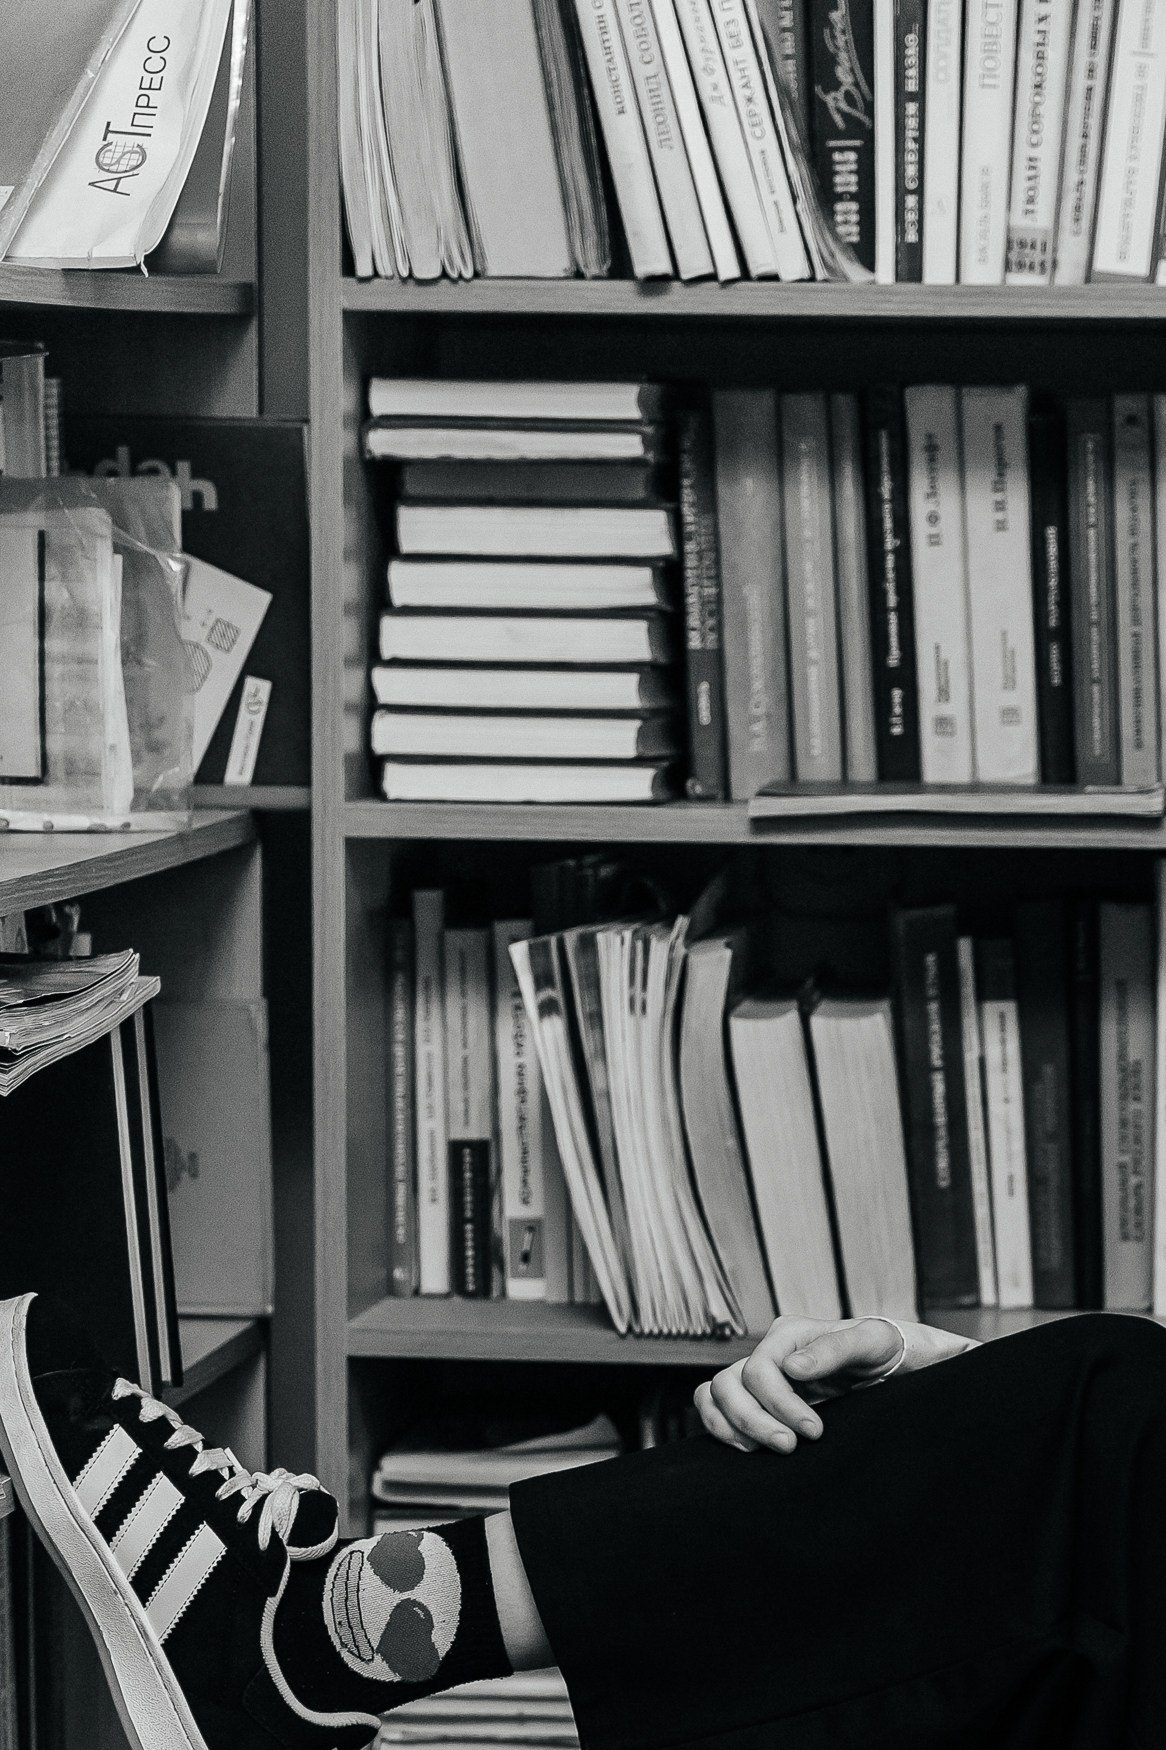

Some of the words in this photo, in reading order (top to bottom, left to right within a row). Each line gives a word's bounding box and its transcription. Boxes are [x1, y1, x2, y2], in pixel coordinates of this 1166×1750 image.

[597, 14, 627, 116] КОНСТАНТИН
[721, 18, 745, 51] БЕЗ
[903, 32, 920, 93] НАЗЛО
[643, 72, 675, 151] ЛЕОНИД
[733, 57, 767, 141] СЕРЖАНТ
[903, 101, 920, 191] СМЕРТЯМ
[903, 194, 920, 244] ВСЕМ
